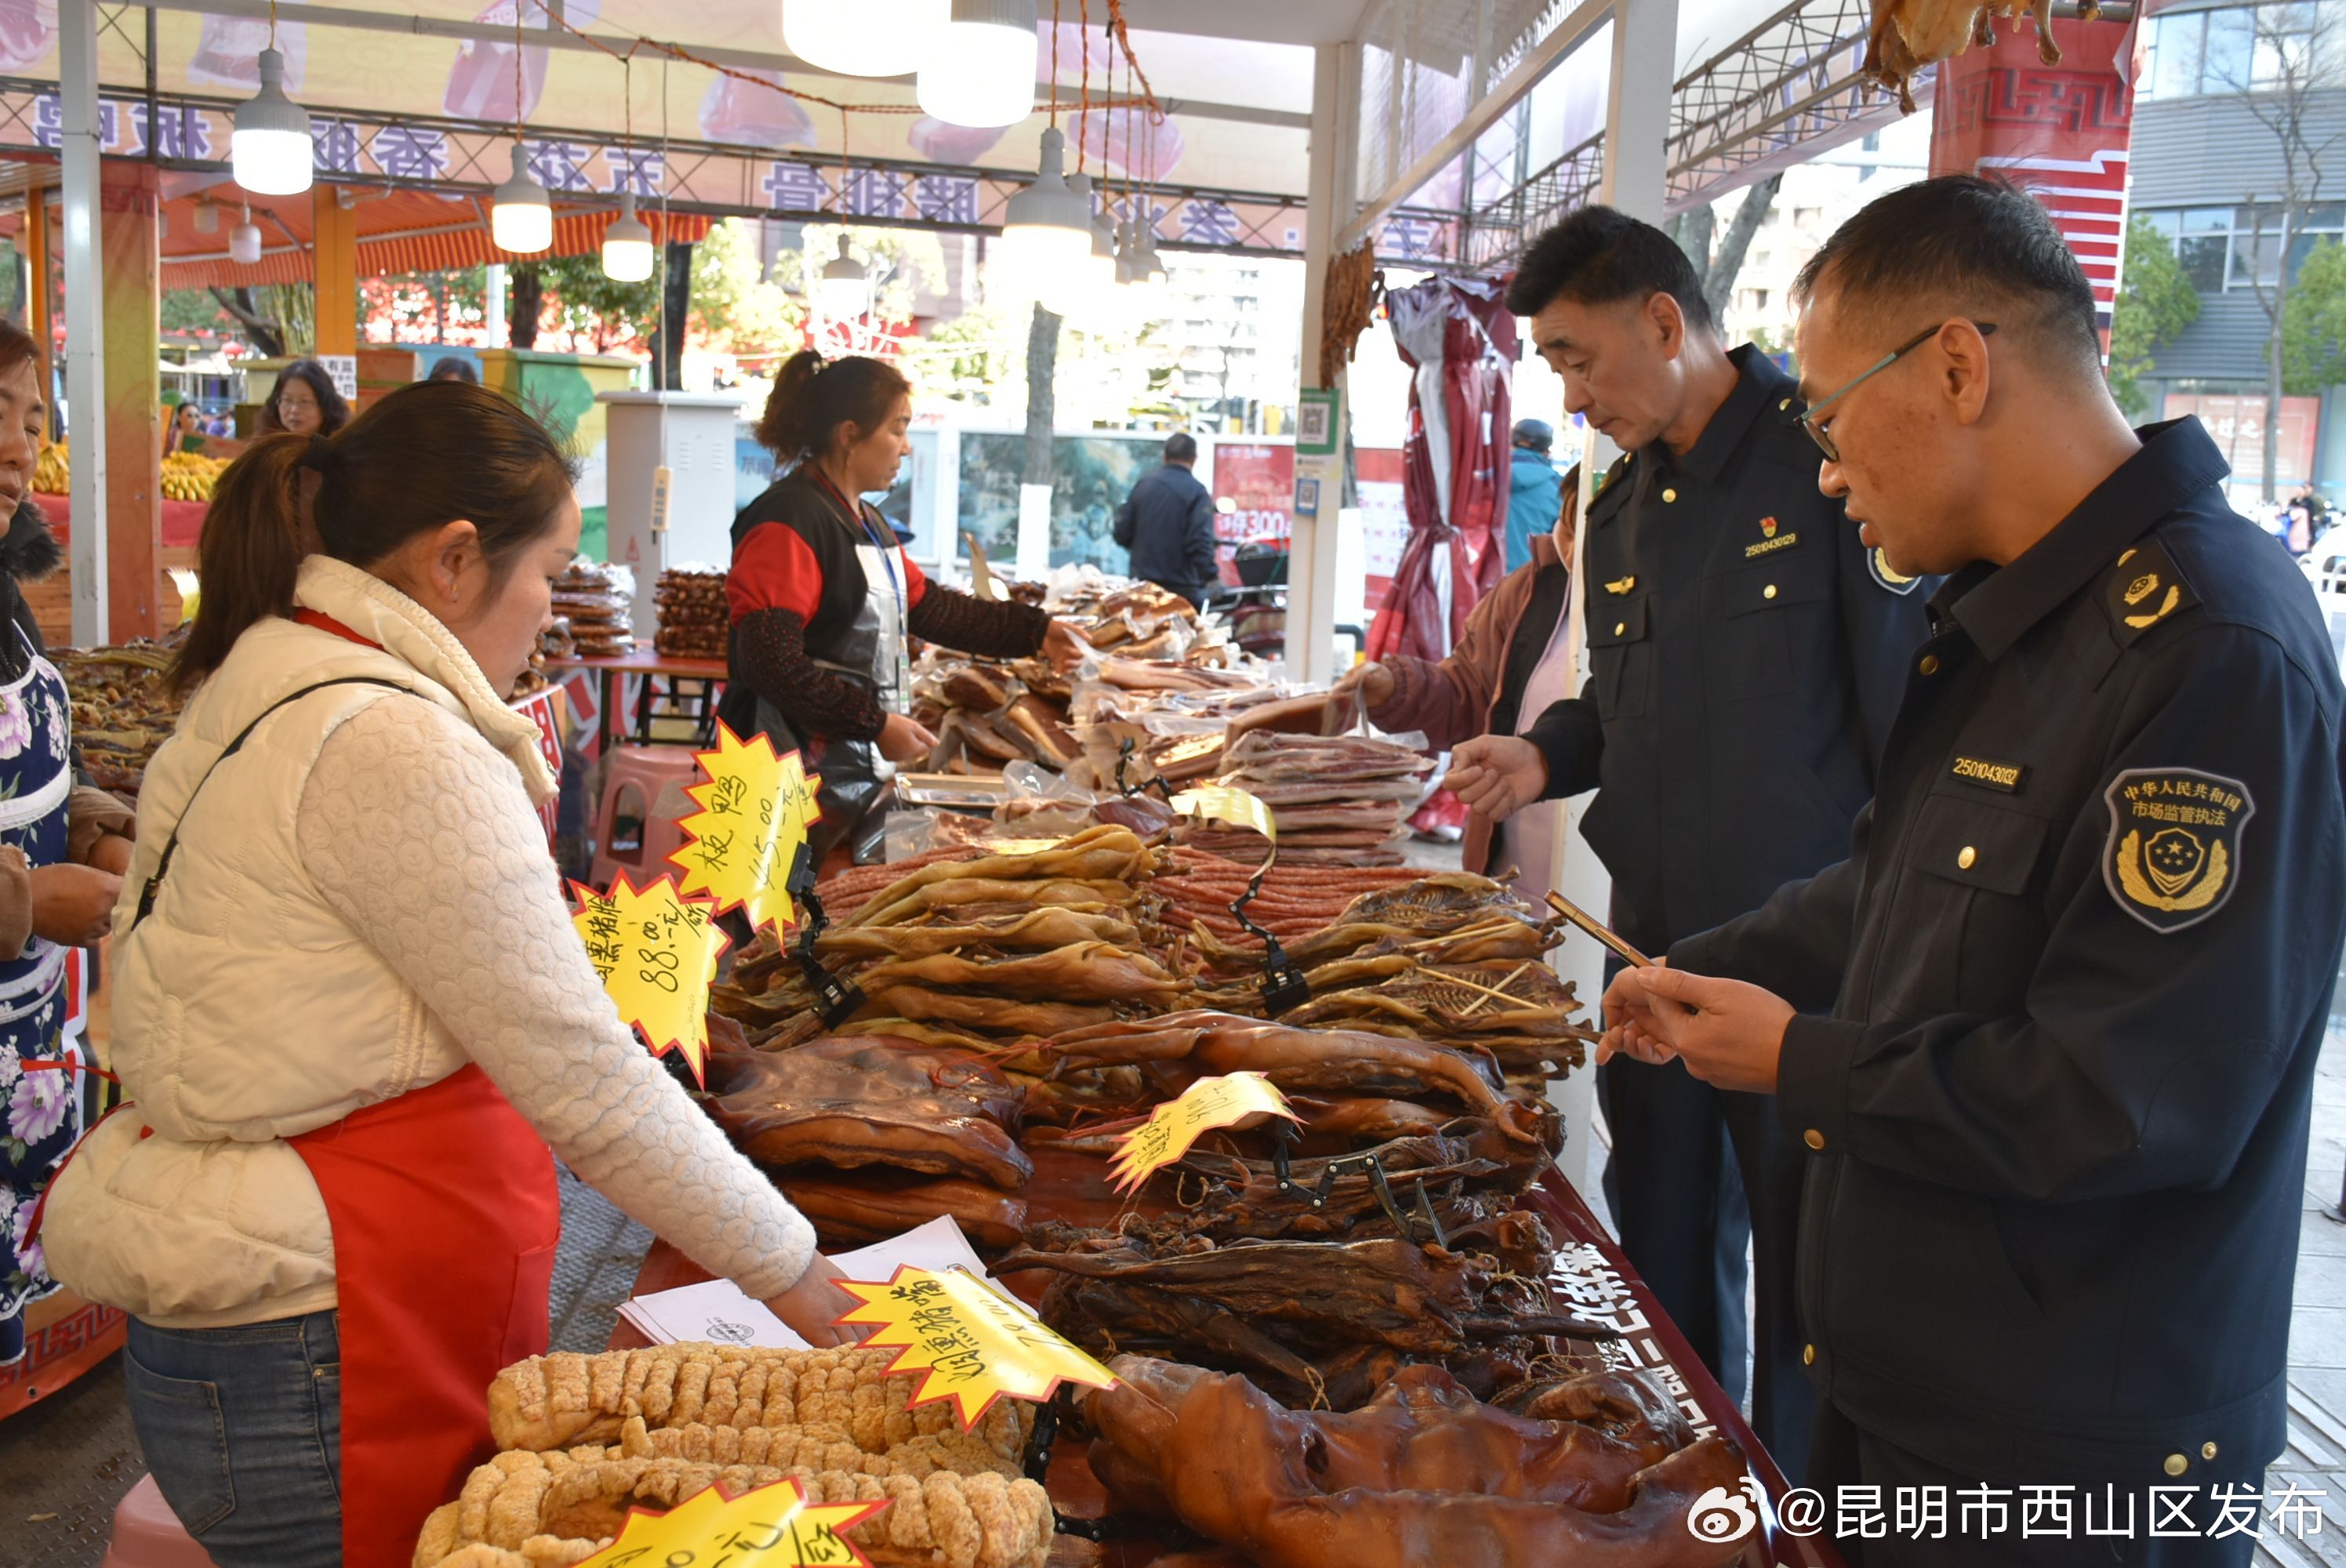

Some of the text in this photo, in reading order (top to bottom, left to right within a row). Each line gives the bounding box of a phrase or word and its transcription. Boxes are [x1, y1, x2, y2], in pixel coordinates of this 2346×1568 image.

[1745, 532, 1796, 557] 25010430129
[1952, 757, 2019, 786] 25010430132
[2124, 779, 2242, 813] 中华人民共和国
[692, 775, 747, 873] 板鸭
[2131, 800, 2227, 827] 市场监管执法
